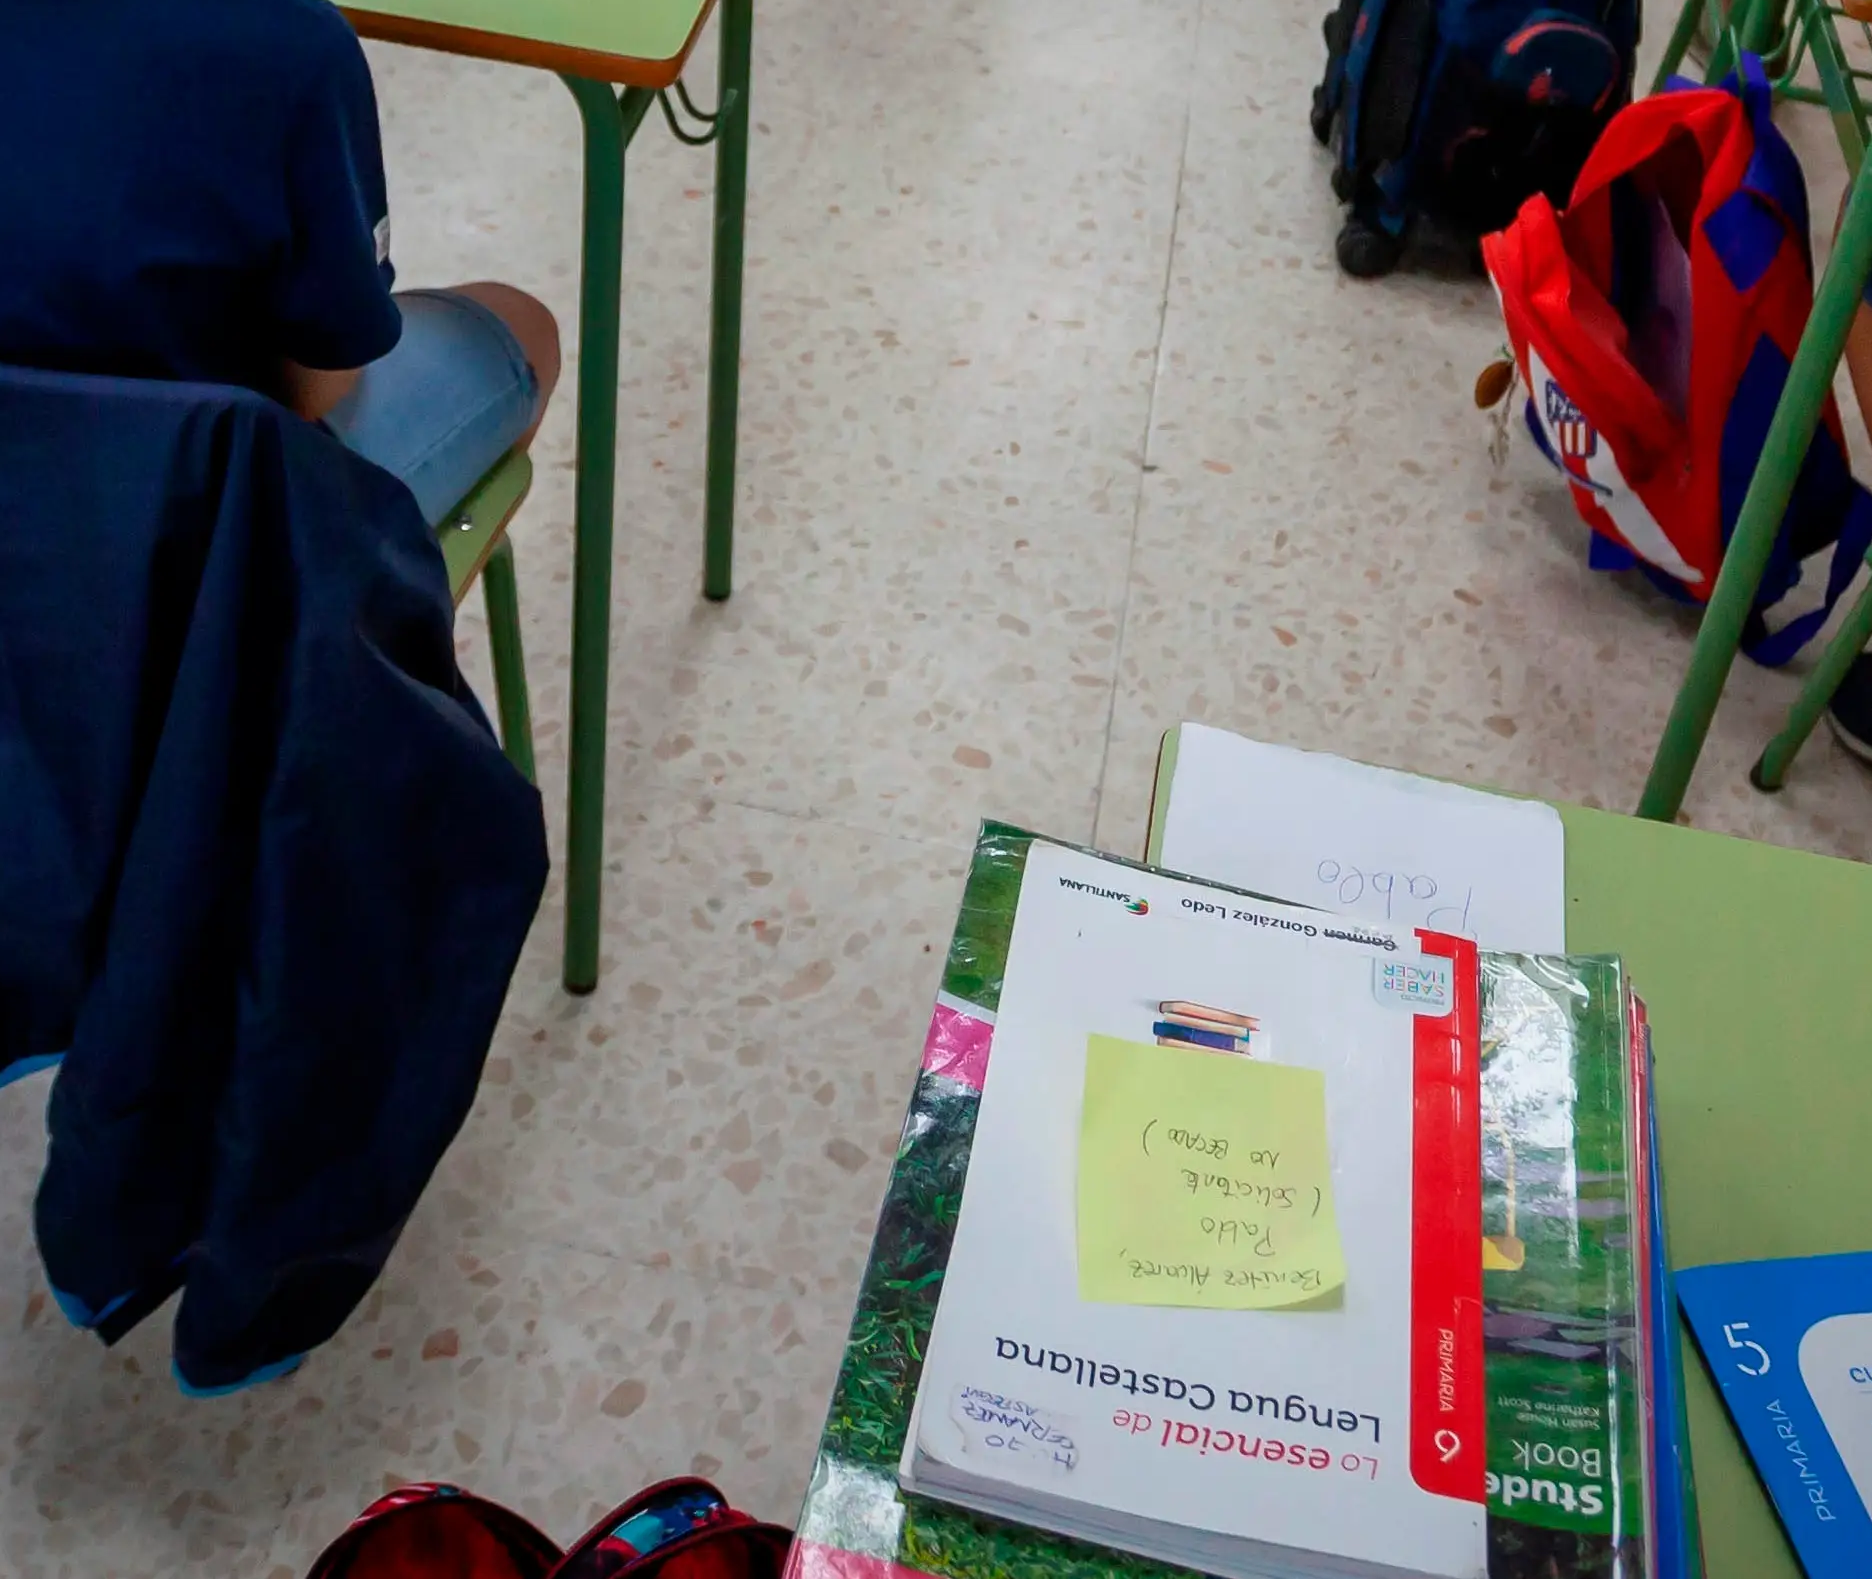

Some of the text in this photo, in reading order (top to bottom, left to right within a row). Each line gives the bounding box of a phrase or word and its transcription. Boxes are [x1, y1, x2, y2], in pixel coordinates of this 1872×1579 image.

[1058, 876, 1131, 904] SANTILLANA
[1317, 858, 1477, 941] Pablo
[1181, 897, 1226, 920] Ledo
[1231, 909, 1317, 939] González
[1384, 964, 1445, 984] HACER
[1384, 977, 1445, 997] SABER
[1199, 1217, 1275, 1257] Pablo
[1722, 1321, 1772, 1377] 5
[1438, 1328, 1455, 1412] PRIMARIA
[994, 1337, 1381, 1444] Lengua Castellana
[1497, 1396, 1532, 1411] Scott
[1561, 1418, 1600, 1430] Susan
[1112, 1408, 1379, 1481] Lo esencial de
[1434, 1429, 1461, 1463] 6
[1511, 1439, 1602, 1478] Book
[1764, 1399, 1836, 1522] PRIMARIA
